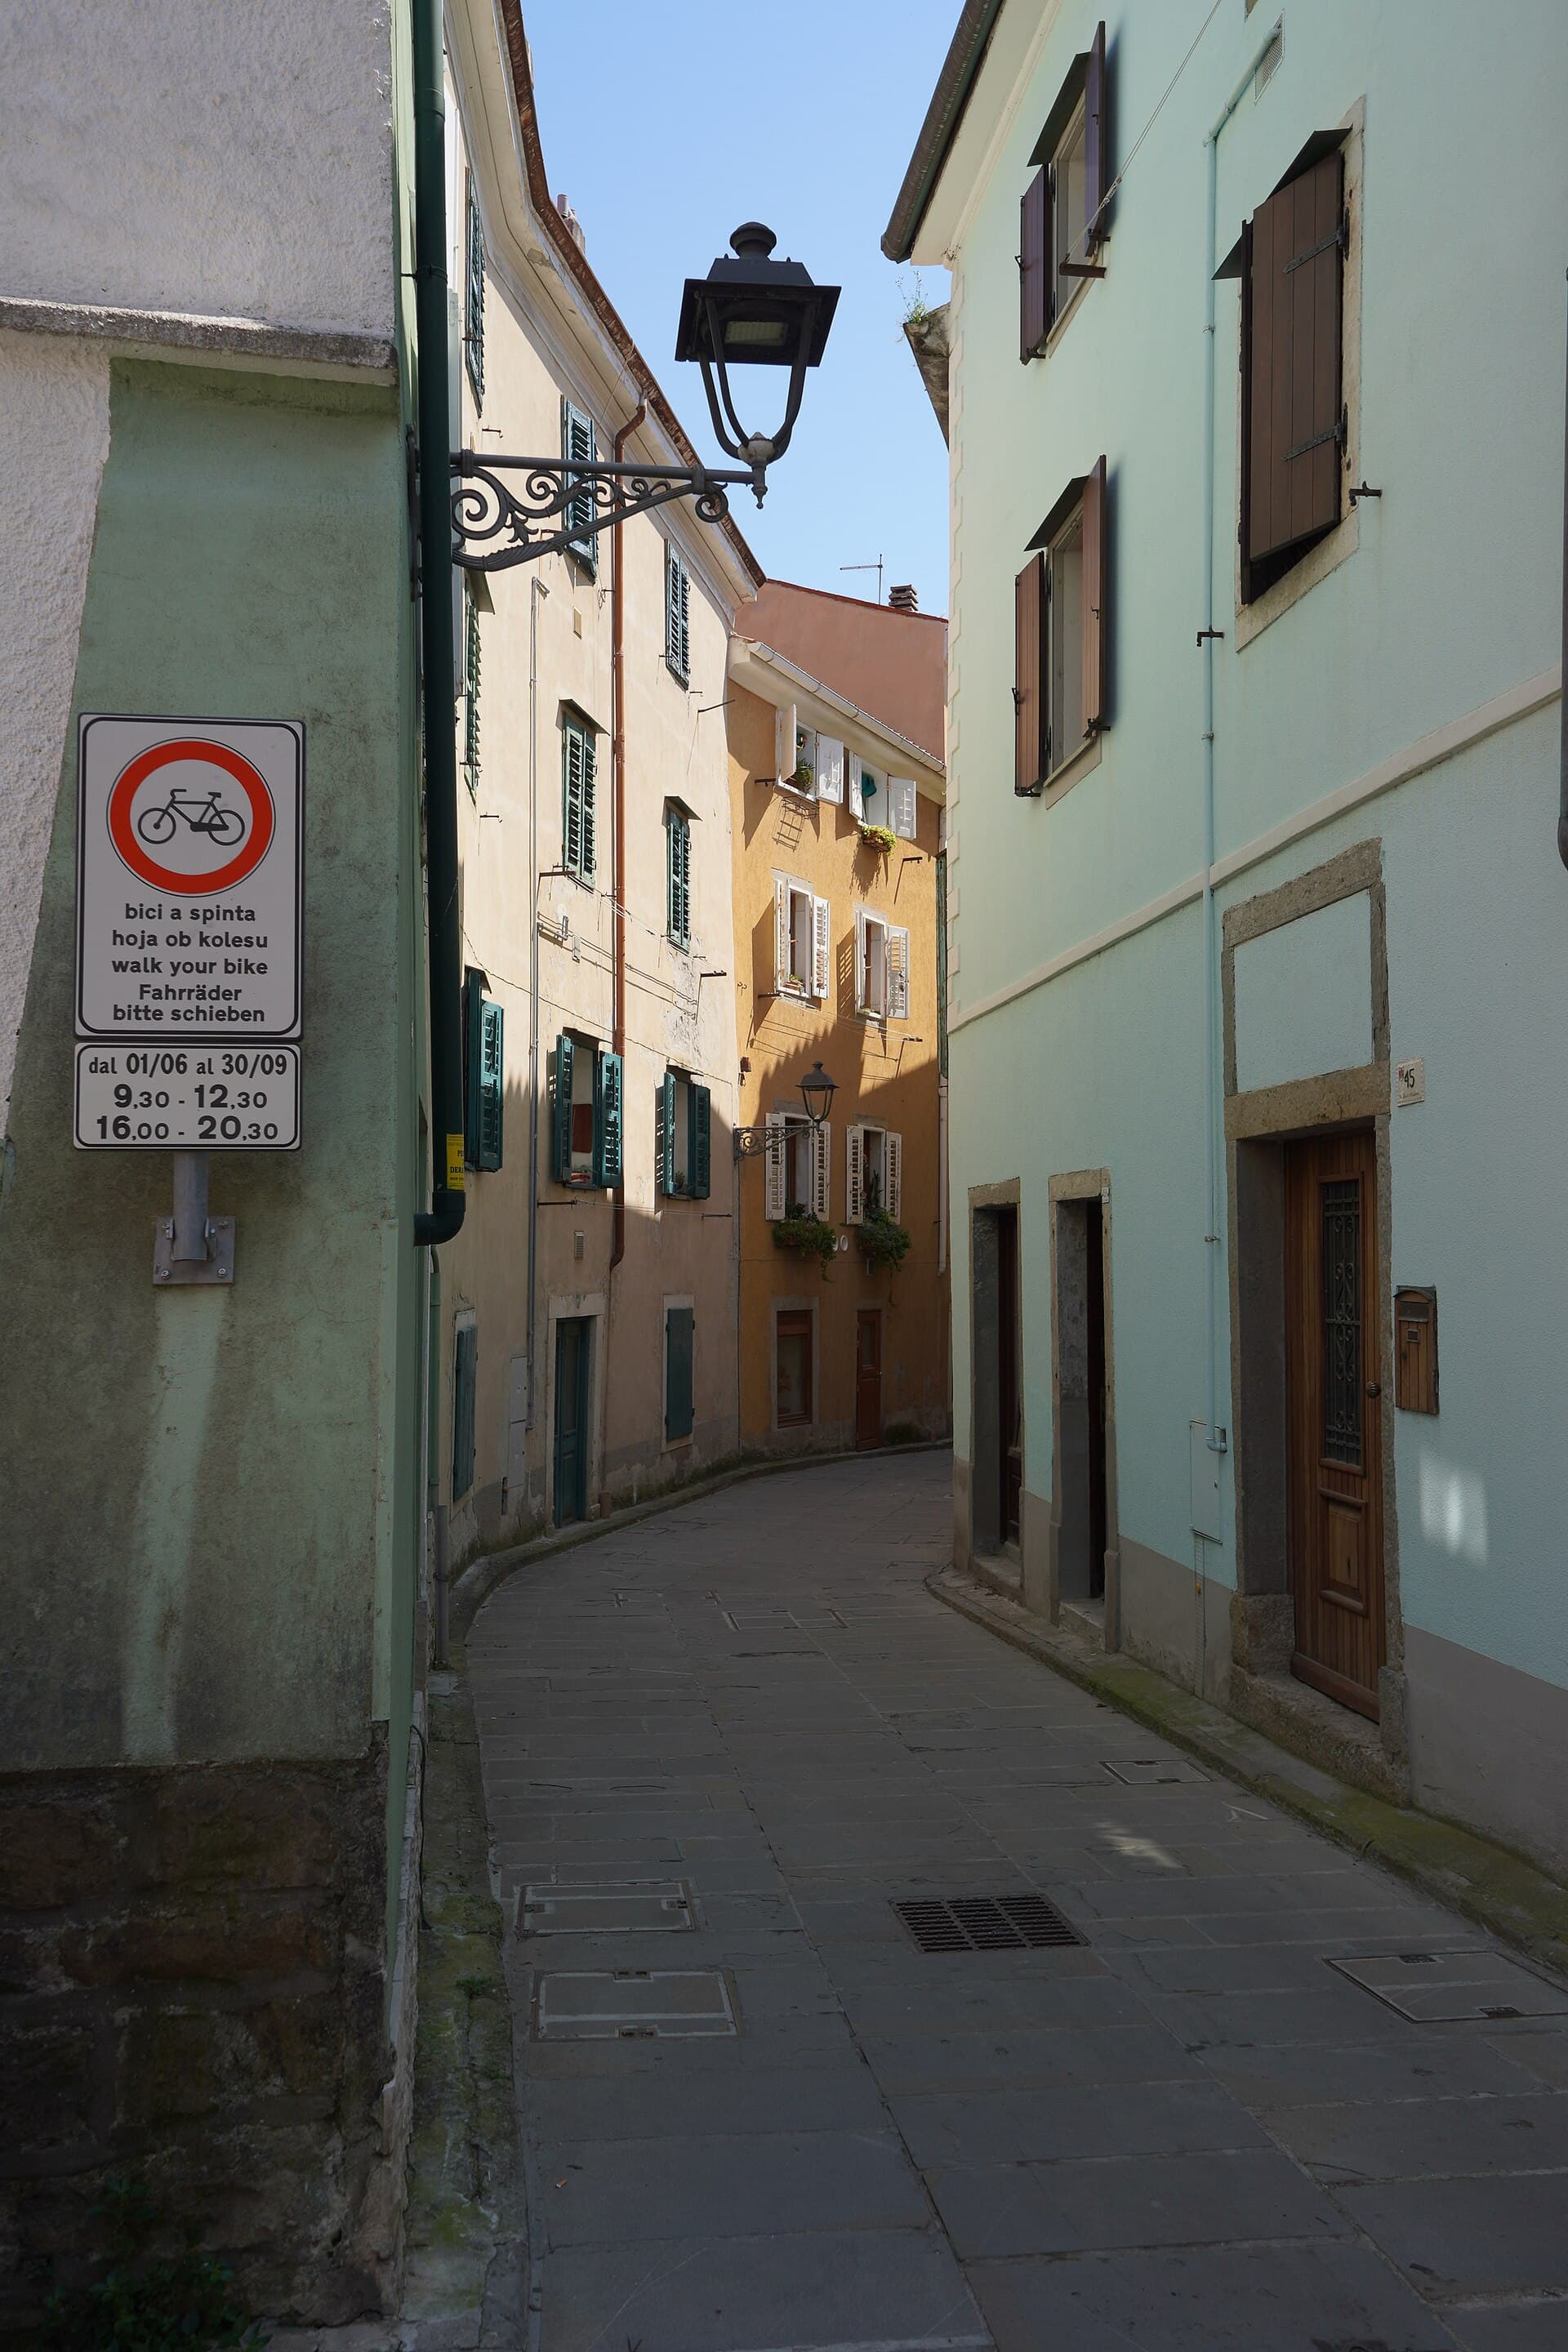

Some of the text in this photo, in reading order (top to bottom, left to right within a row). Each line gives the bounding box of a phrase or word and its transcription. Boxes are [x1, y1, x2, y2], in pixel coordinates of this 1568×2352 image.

[126, 903, 256, 924] bici a spinta
[113, 930, 268, 949] hoja ob kolesu
[112, 957, 268, 977] walk your bike
[140, 984, 242, 1000] Fahrräder
[114, 1004, 265, 1022] bitte schieben
[88, 1053, 287, 1078] dal 01/06 al 30/09
[1404, 1068, 1415, 1089] 45
